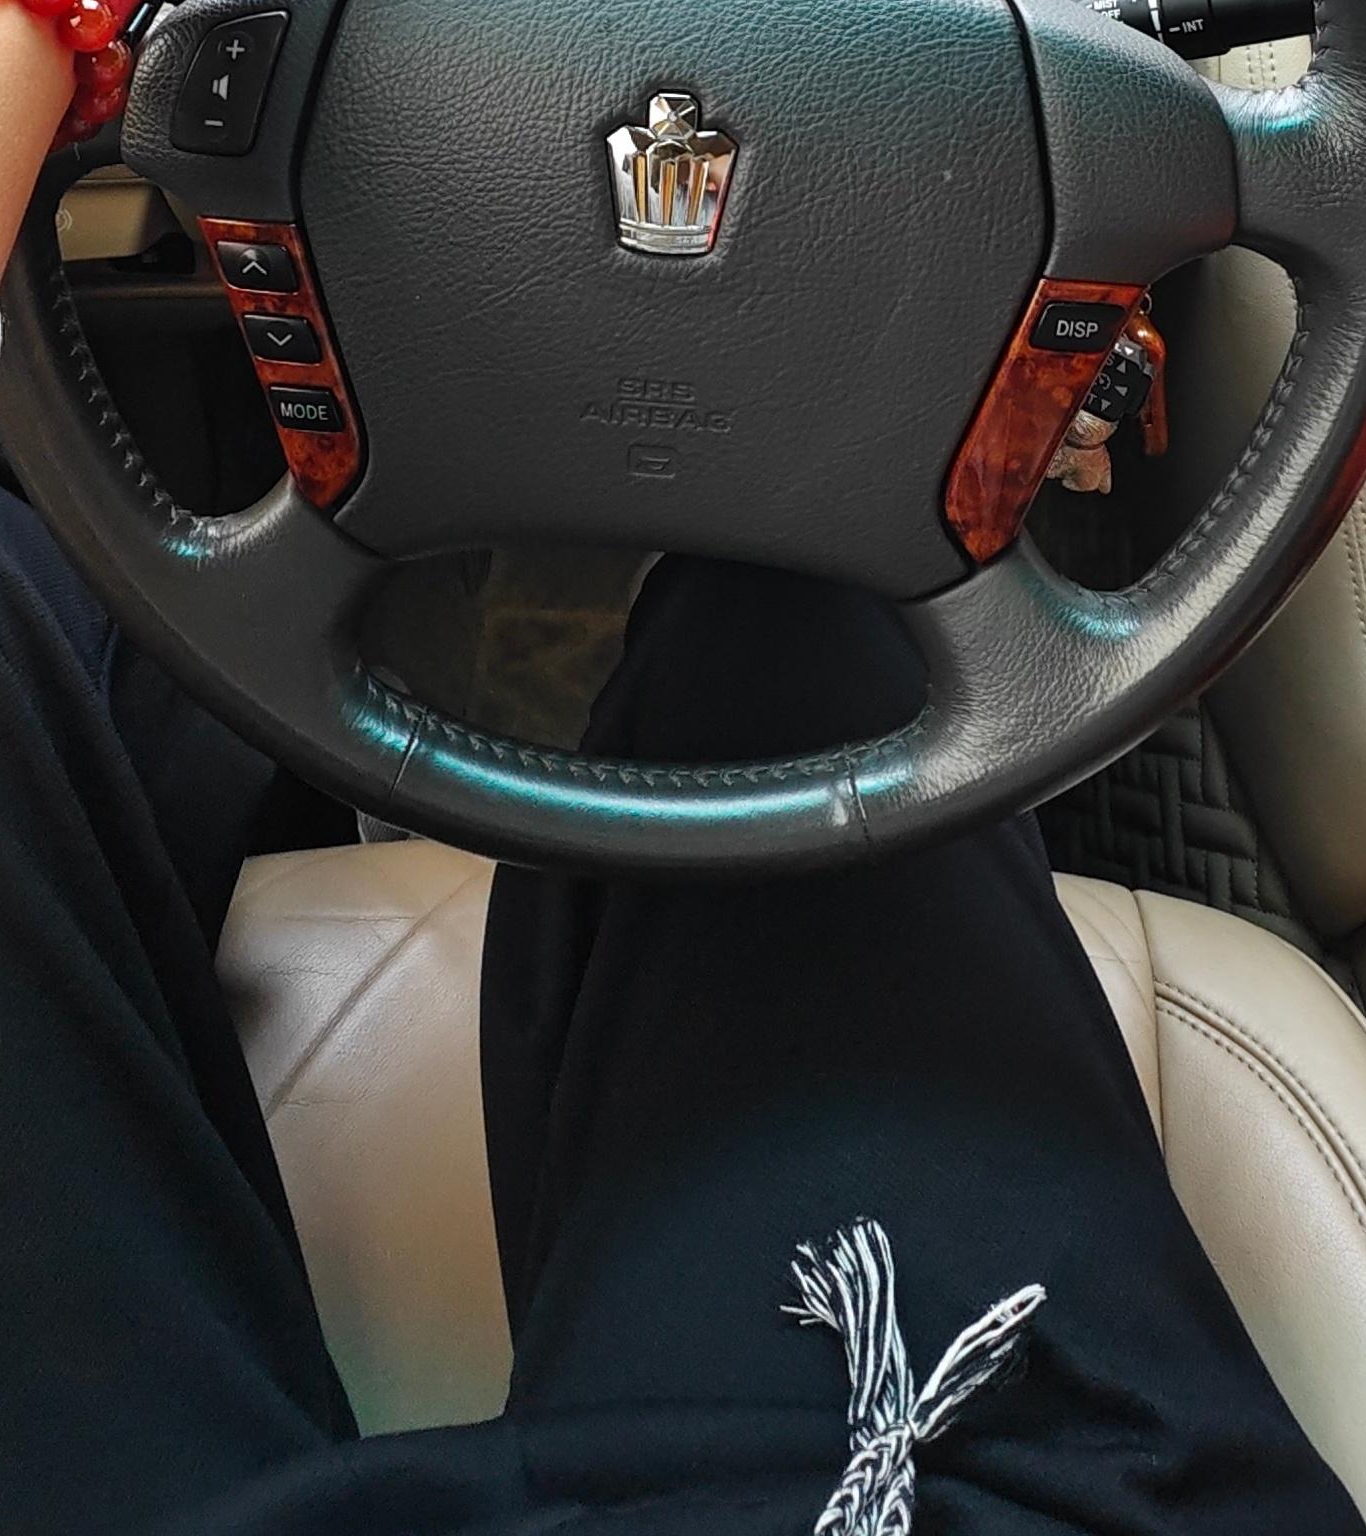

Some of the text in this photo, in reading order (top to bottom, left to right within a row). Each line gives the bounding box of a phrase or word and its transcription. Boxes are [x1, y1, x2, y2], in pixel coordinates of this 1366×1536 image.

[1182, 19, 1204, 34] INT
[1056, 319, 1099, 339] DISP
[619, 378, 696, 401] SRS
[280, 402, 329, 420] MODE
[580, 402, 732, 433] AIRBAG
